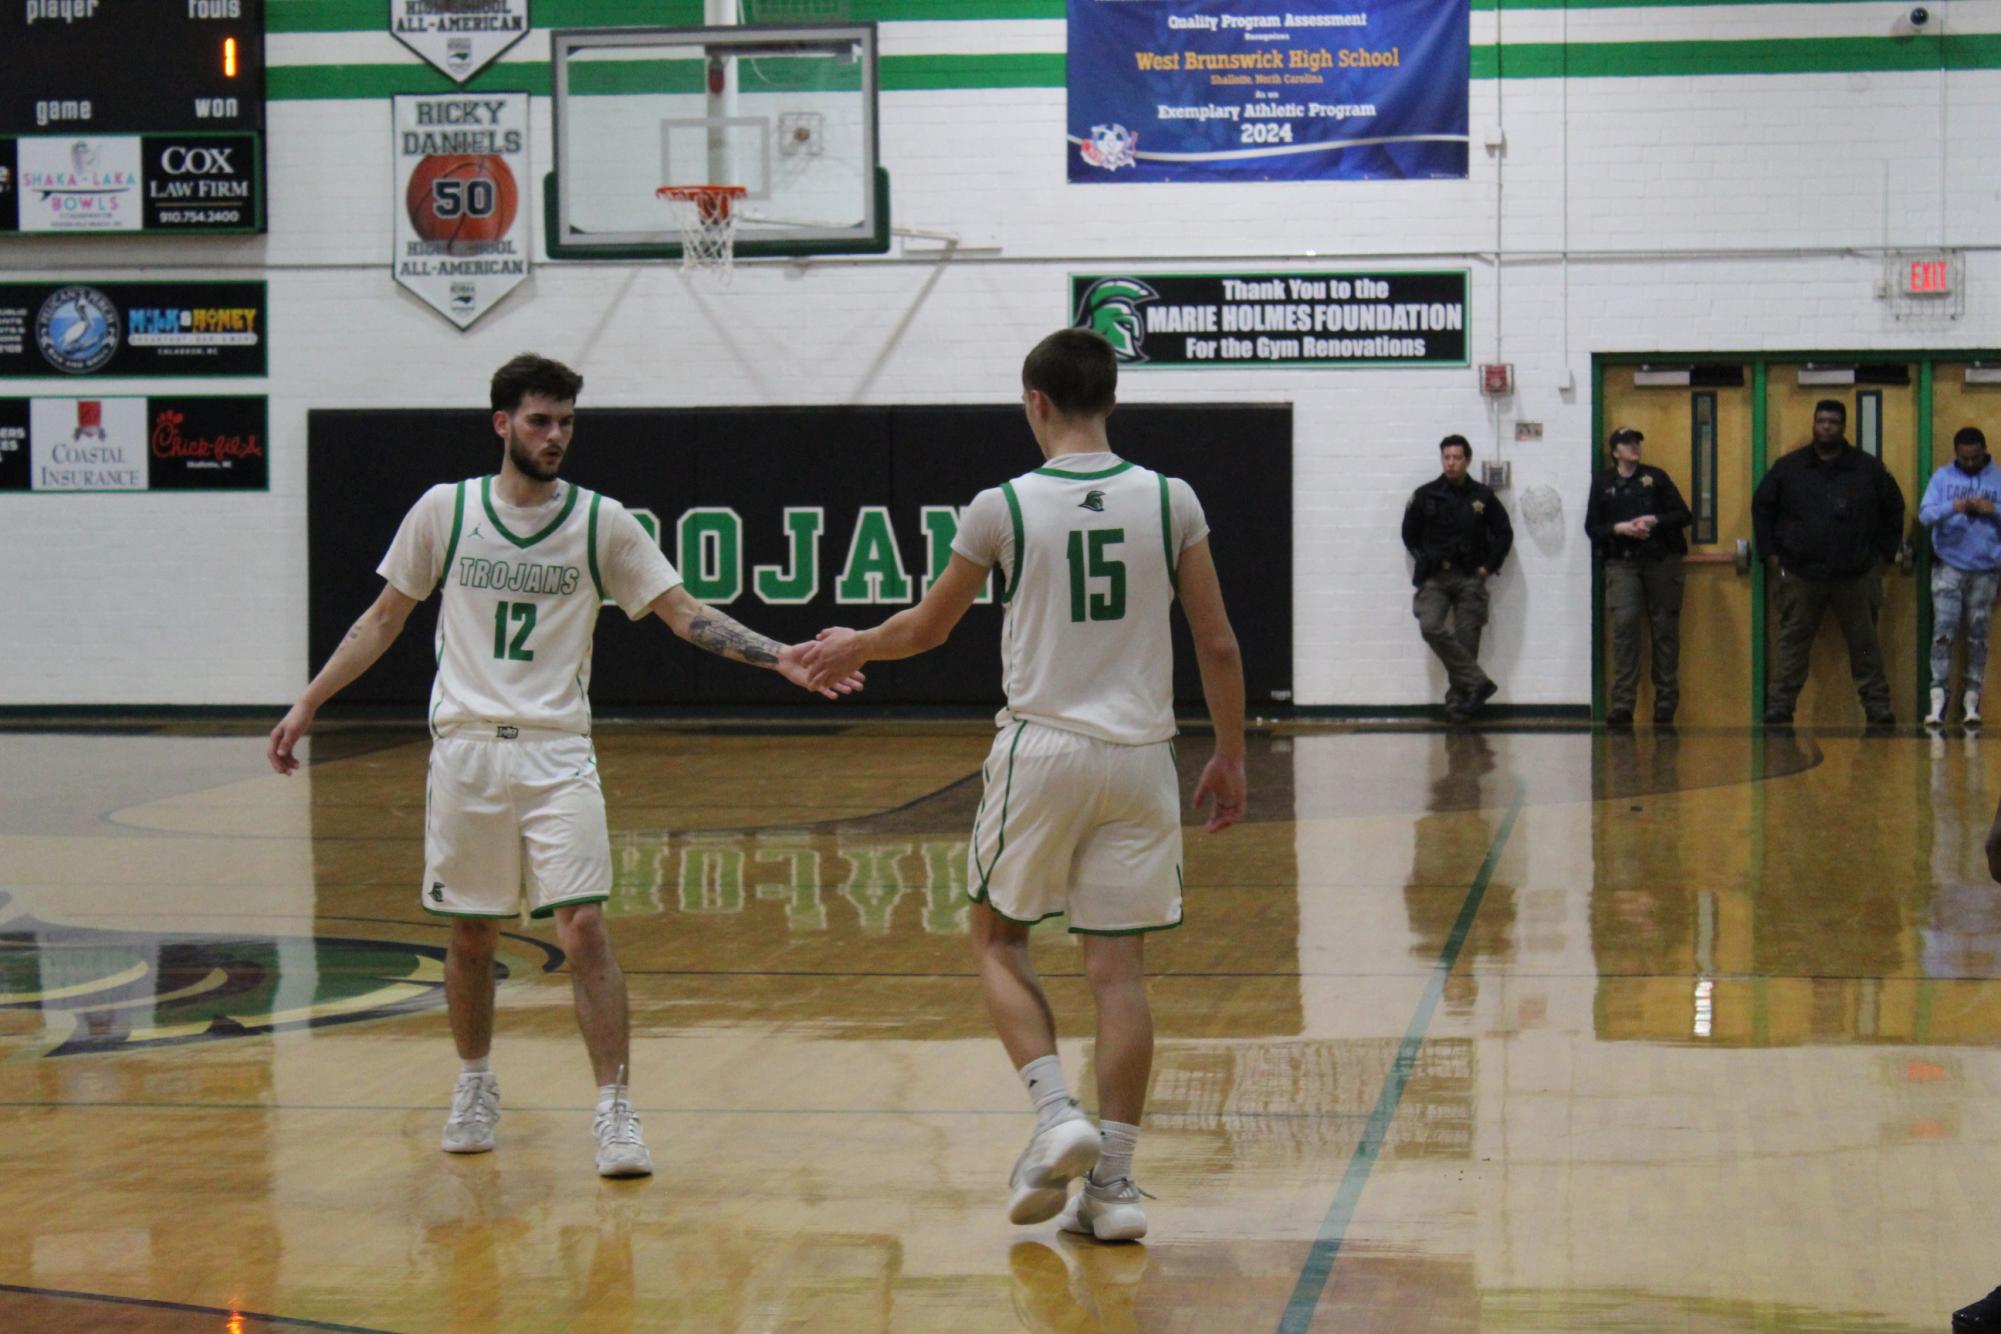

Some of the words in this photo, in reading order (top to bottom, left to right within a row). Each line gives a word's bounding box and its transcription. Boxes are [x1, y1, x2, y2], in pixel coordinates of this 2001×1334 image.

[26, 0, 98, 24] player
[188, 0, 241, 19] fouls
[1168, 14, 1218, 31] Quality
[1221, 13, 1281, 30] Program
[1284, 12, 1368, 27] Assessment
[396, 16, 523, 32] ALL-AMERICAN
[1135, 51, 1180, 71] West
[1184, 49, 1284, 70] Brunswick
[1289, 48, 1333, 72] High
[1338, 47, 1400, 67] School
[36, 100, 92, 126] game
[195, 98, 238, 118] won
[416, 101, 506, 125] RICKY
[1157, 104, 1240, 121] Exemplary
[1244, 102, 1304, 118] Athletic
[1308, 102, 1377, 119] Program
[402, 131, 522, 156] DANIELS
[1240, 122, 1293, 143] 2024
[161, 146, 234, 175] COX
[149, 180, 194, 198] LAW
[198, 180, 249, 198] FIRM
[432, 178, 497, 219] 50
[51, 196, 120, 212] BOWLS
[400, 260, 524, 276] ALL-AMERICAN
[1911, 261, 1947, 291] EXIT
[1222, 279, 1286, 301] Thank
[1289, 278, 1326, 300] You
[1329, 279, 1351, 300] to
[1354, 278, 1389, 299] the
[193, 309, 257, 334] HONEY
[1147, 305, 1218, 333] MARIE
[1222, 303, 1312, 332] HOLMES
[1314, 302, 1462, 332] FOUNDATION
[1185, 337, 1217, 359] For
[1220, 336, 1253, 358] the
[1256, 336, 1300, 360] Gym
[1303, 335, 1426, 358] Renovations
[52, 443, 126, 464] COASTAL
[42, 466, 140, 486] INSURANCE
[459, 556, 581, 596] TROJANS
[1066, 527, 1126, 622] 15
[493, 600, 538, 662] 12
